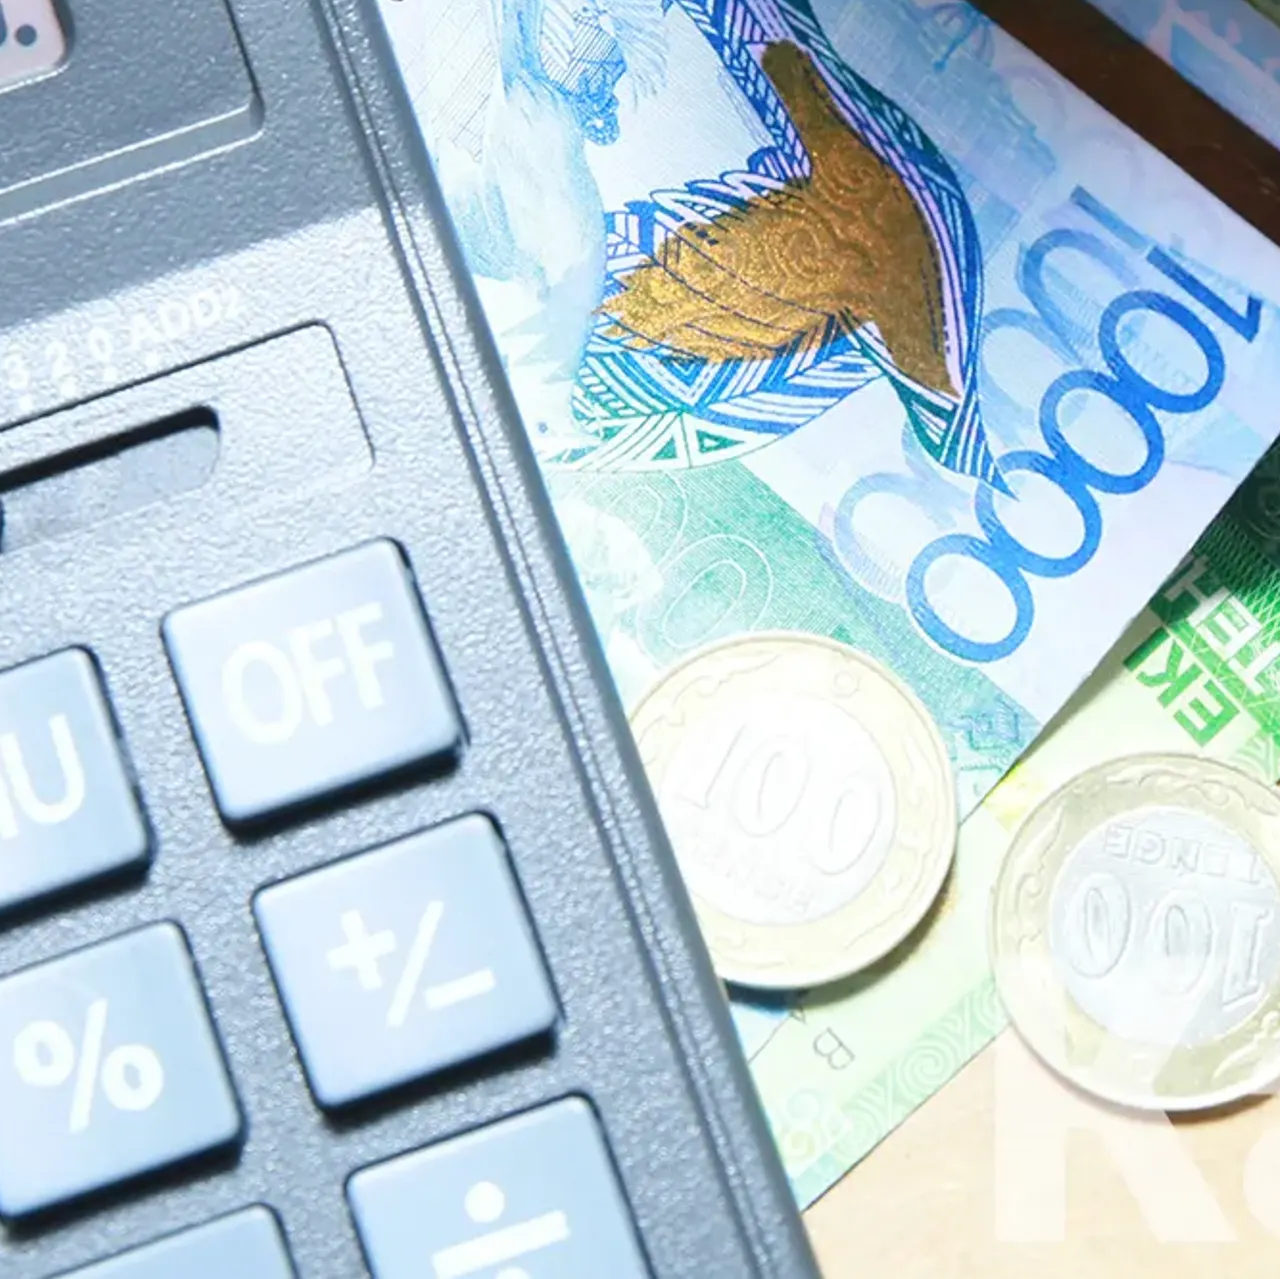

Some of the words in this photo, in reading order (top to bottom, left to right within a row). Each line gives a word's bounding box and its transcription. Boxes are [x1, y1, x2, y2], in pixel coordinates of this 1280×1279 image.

[904, 246, 1265, 664] 10000
[220, 600, 394, 746] OFF
[13, 998, 165, 1133] %
